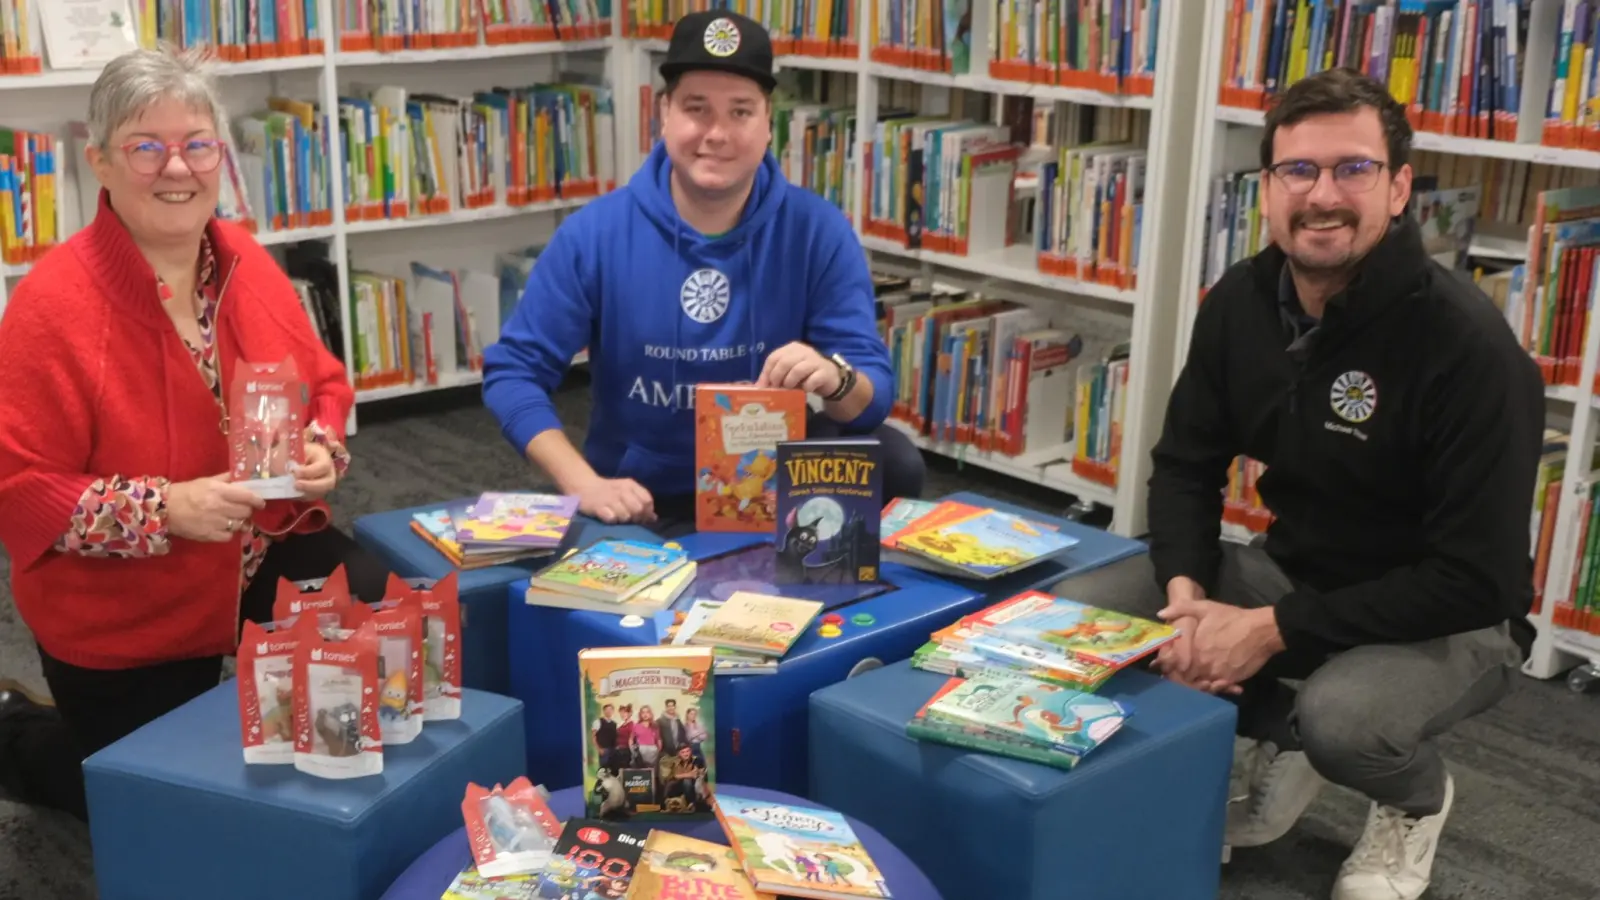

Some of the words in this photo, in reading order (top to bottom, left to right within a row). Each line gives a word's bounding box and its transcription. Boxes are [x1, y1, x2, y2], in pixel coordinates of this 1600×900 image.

[644, 344, 698, 362] ROUND
[700, 344, 747, 362] TABLE
[784, 457, 876, 487] VINCENT
[323, 651, 356, 663] tonies
[564, 844, 632, 878] 100
